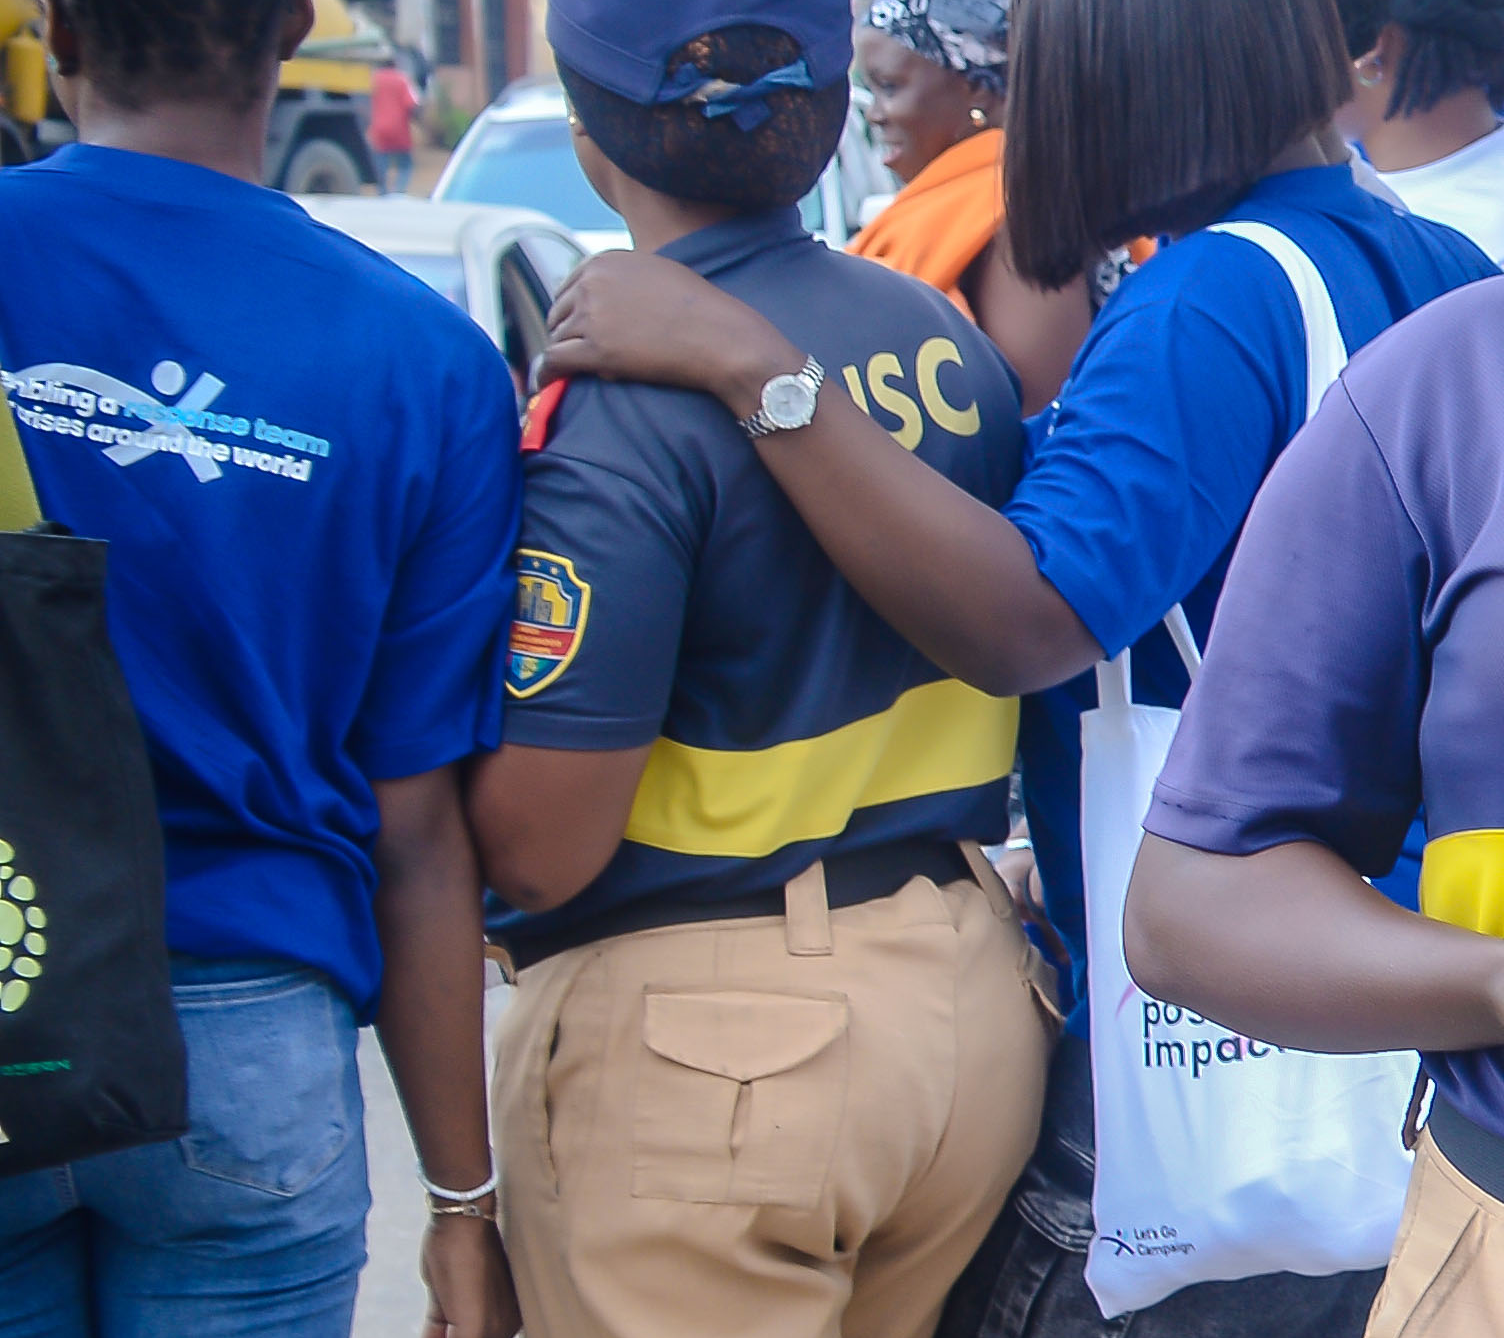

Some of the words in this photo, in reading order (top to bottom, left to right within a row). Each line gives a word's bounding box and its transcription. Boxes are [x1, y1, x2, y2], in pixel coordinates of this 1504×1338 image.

[86, 421, 182, 454] around
[186, 434, 231, 462] the
[233, 444, 313, 483] world
[98, 396, 120, 416] a
[124, 400, 250, 437] response
[254, 416, 330, 457] team
[1143, 1037, 1286, 1079] impac
